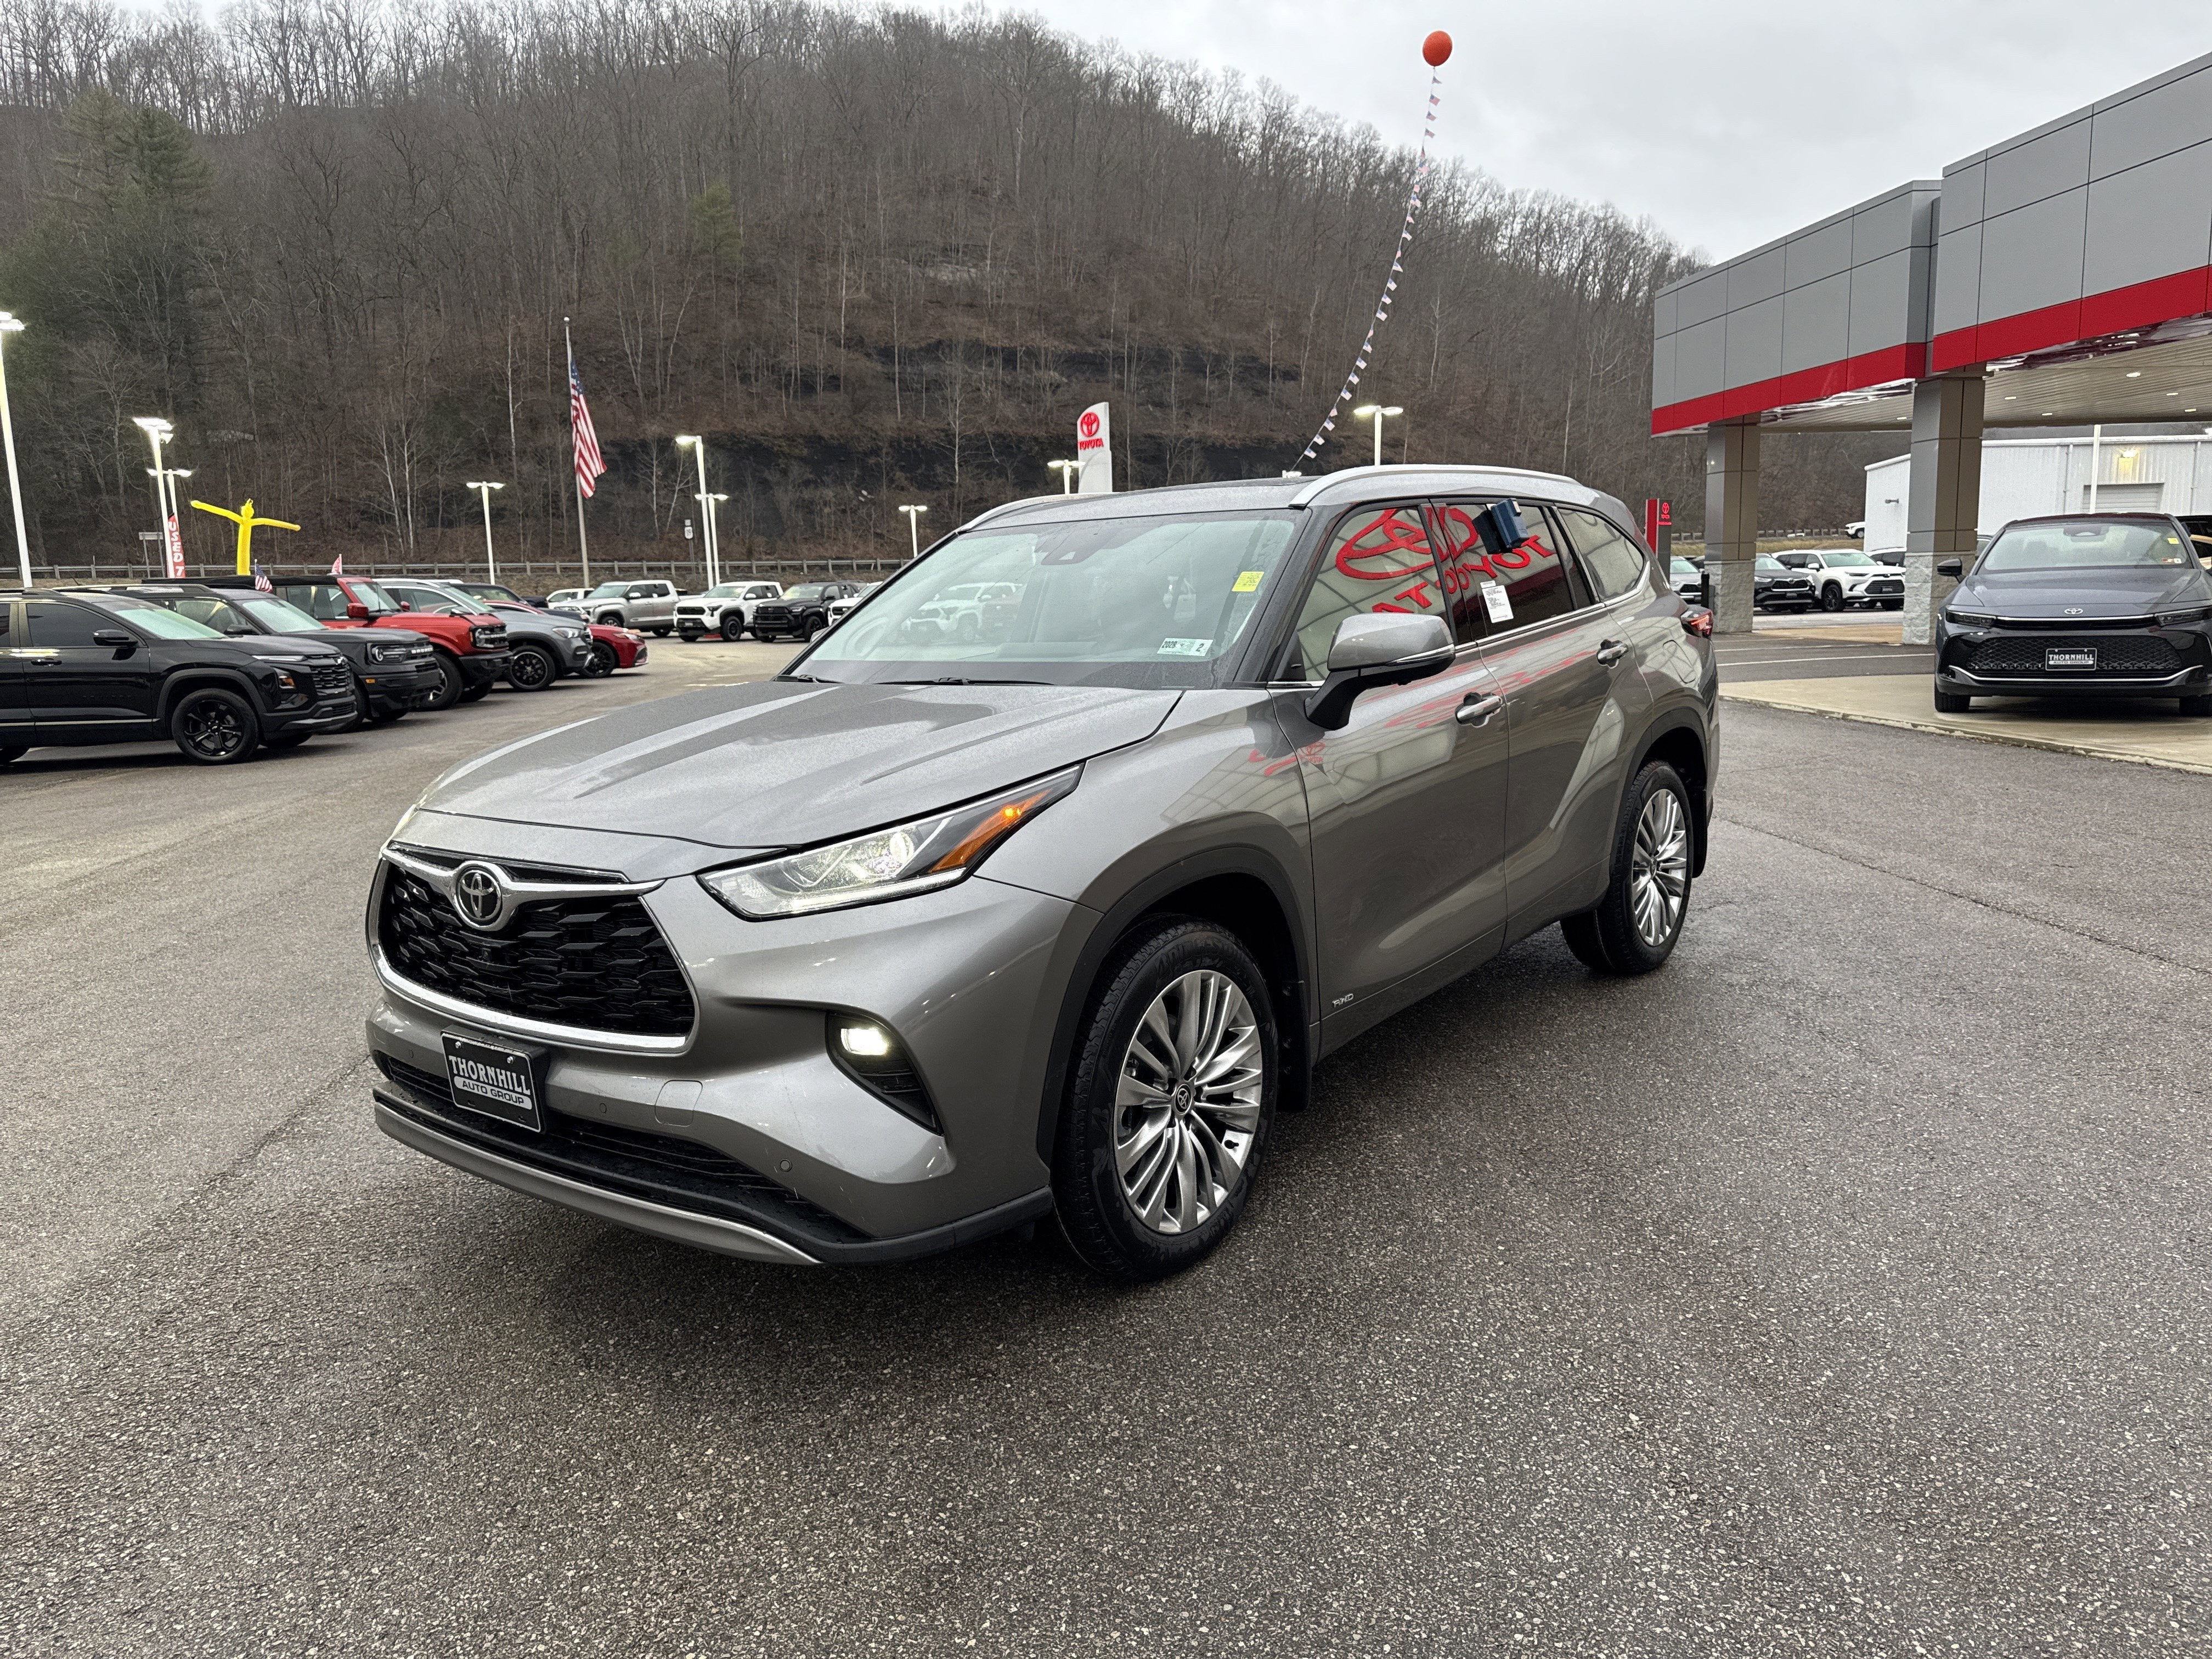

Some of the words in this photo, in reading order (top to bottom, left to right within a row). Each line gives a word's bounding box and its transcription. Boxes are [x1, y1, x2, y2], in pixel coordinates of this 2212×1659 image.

[1079, 438, 1104, 450] TOYOTA
[168, 521, 183, 563] USED
[1195, 644, 1205, 652] 2
[448, 1055, 531, 1096] THORNHILL
[462, 1080, 488, 1094] AUTO
[490, 1088, 524, 1105] GROUP
